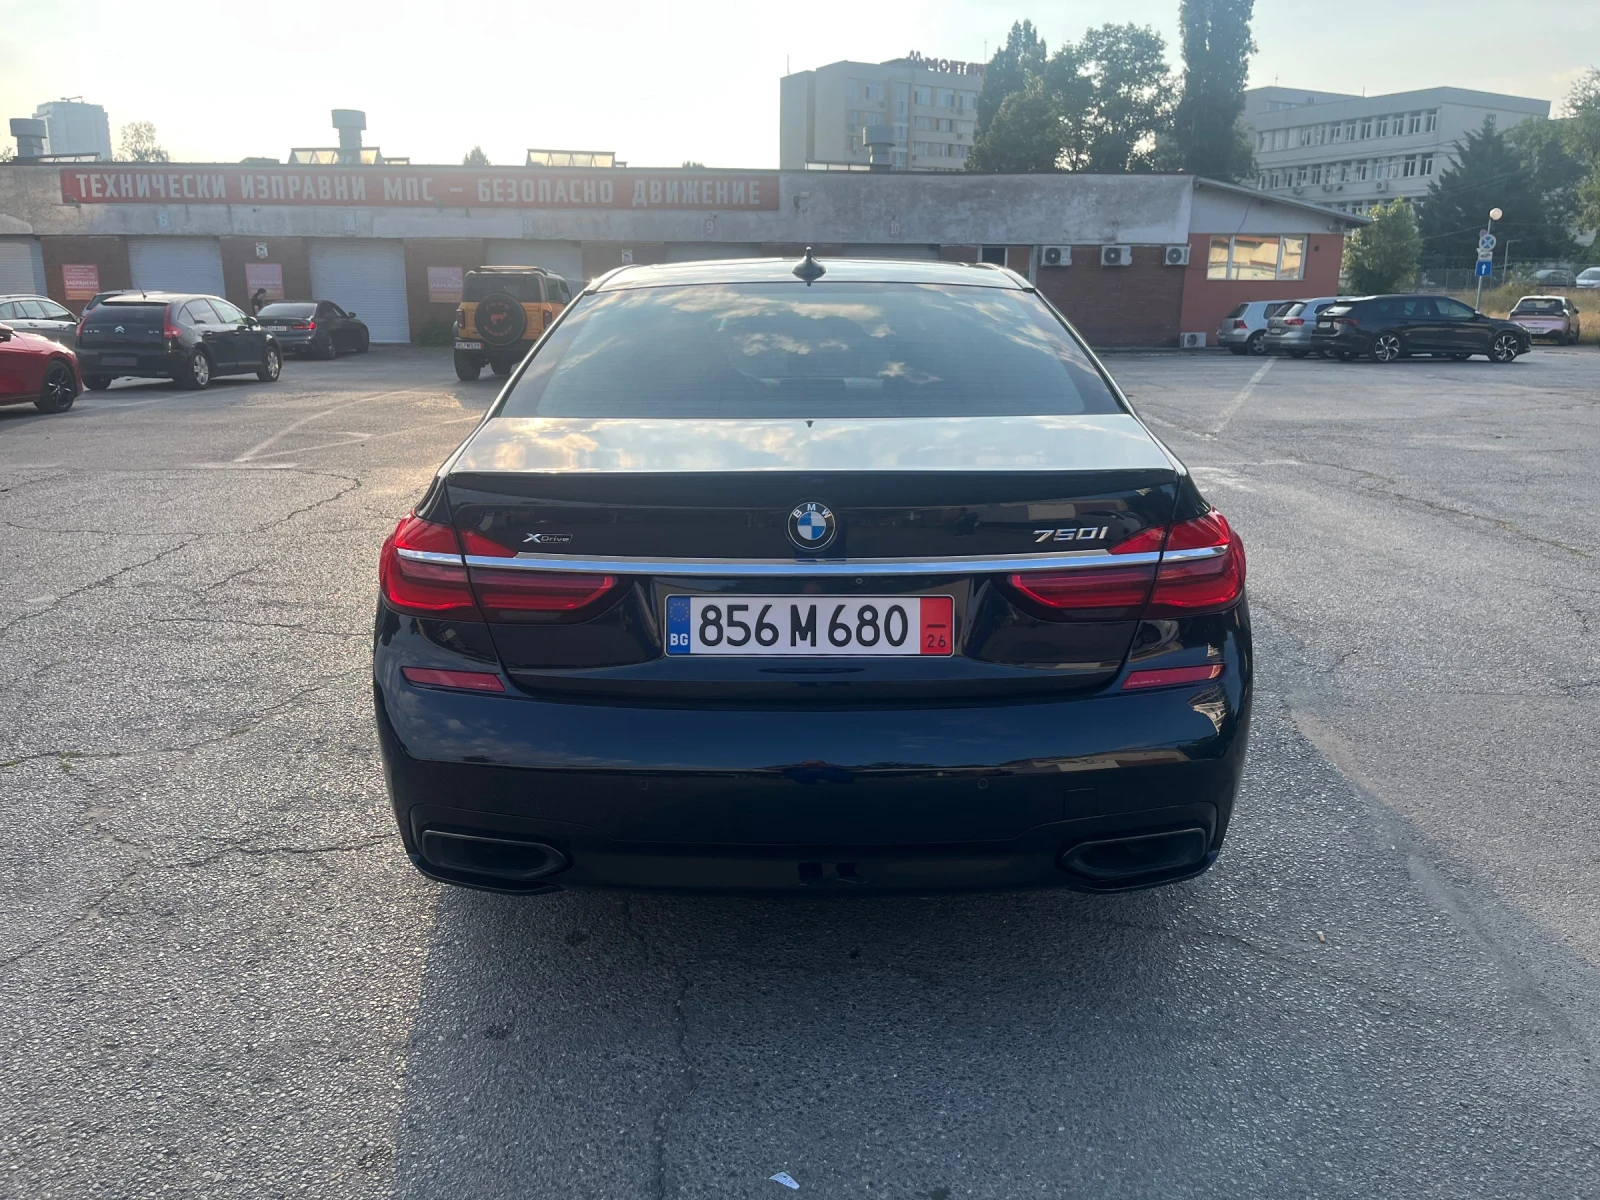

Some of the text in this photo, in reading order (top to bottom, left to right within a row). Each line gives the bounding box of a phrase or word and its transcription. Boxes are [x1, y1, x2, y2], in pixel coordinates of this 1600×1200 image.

[76, 173, 227, 199] ТЕХНИЧЕСКИ
[240, 175, 366, 201] ИЗПРАВНИ
[383, 177, 434, 202] МПС
[477, 178, 614, 204] БЕЗОПАСНО
[632, 179, 761, 207] ДВИЖЕНИЕ
[159, 213, 168, 227] 6
[705, 221, 714, 234] 9
[890, 222, 900, 235] 10
[793, 502, 833, 521] BMW
[698, 604, 909, 647] 856 M 680
[670, 634, 689, 646] BG
[928, 634, 947, 648] 26
